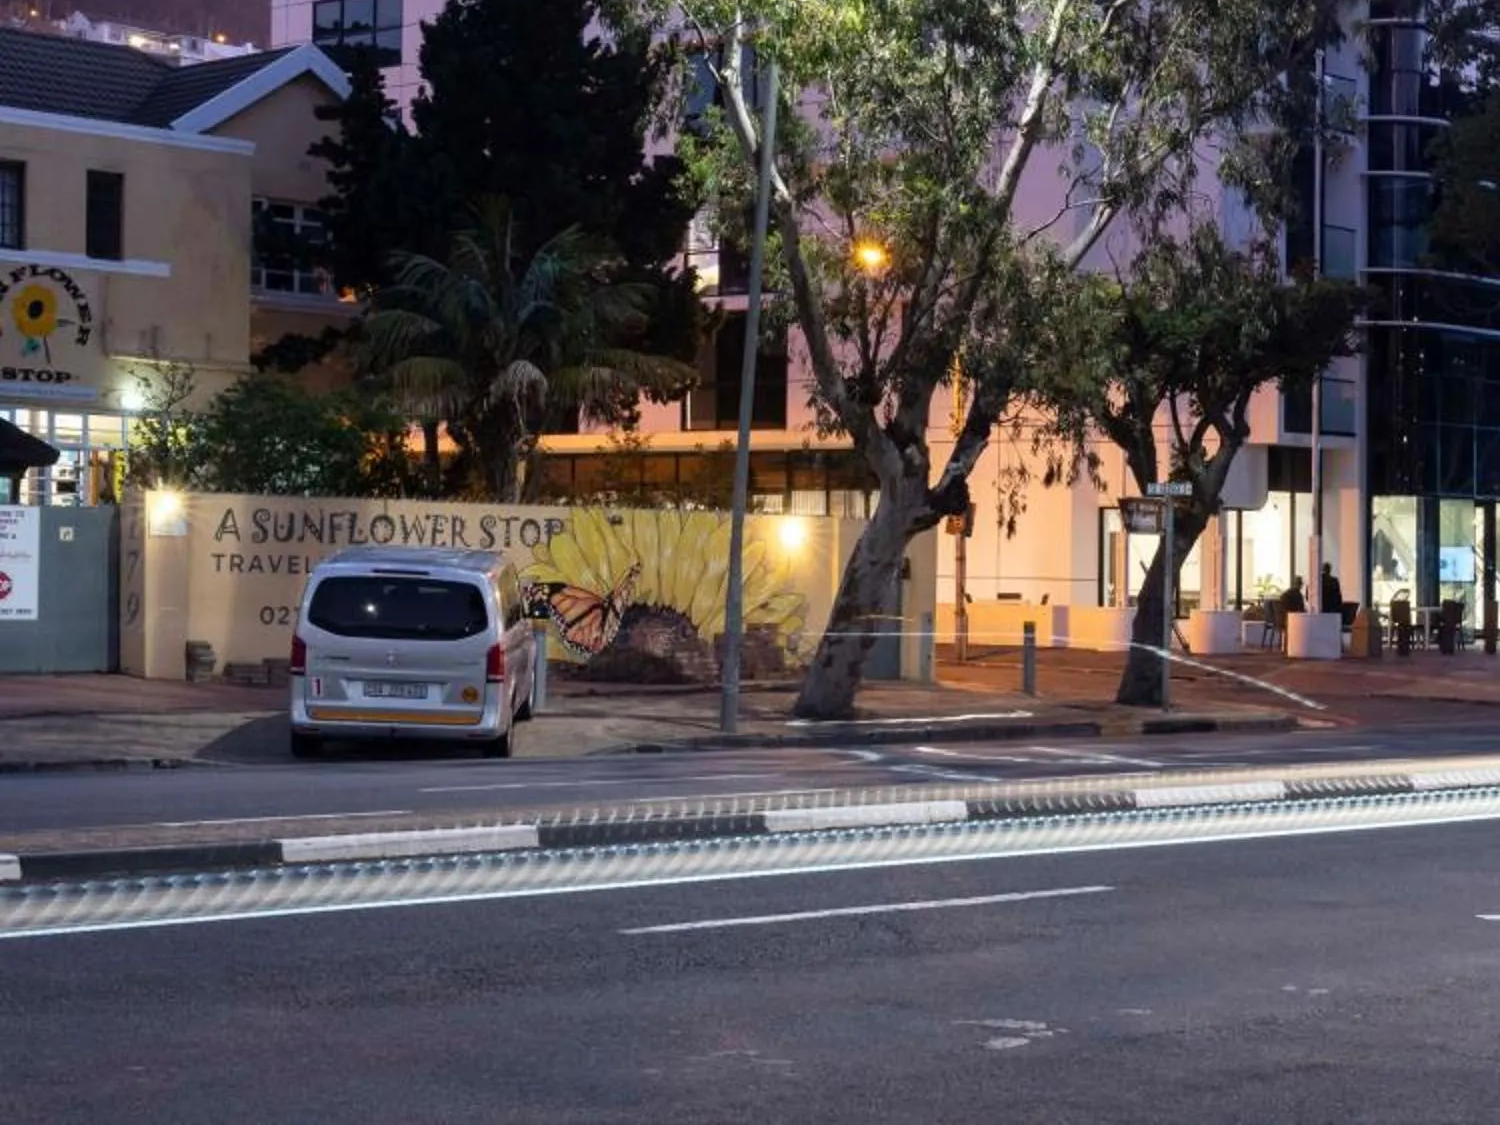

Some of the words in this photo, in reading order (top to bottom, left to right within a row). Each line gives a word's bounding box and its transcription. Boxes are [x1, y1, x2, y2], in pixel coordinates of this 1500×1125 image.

[1, 367, 71, 384] STOP
[214, 507, 241, 542] A
[251, 508, 471, 549] SUNFLOWER
[479, 514, 565, 555] STOP
[211, 553, 316, 574] TRAVEL
